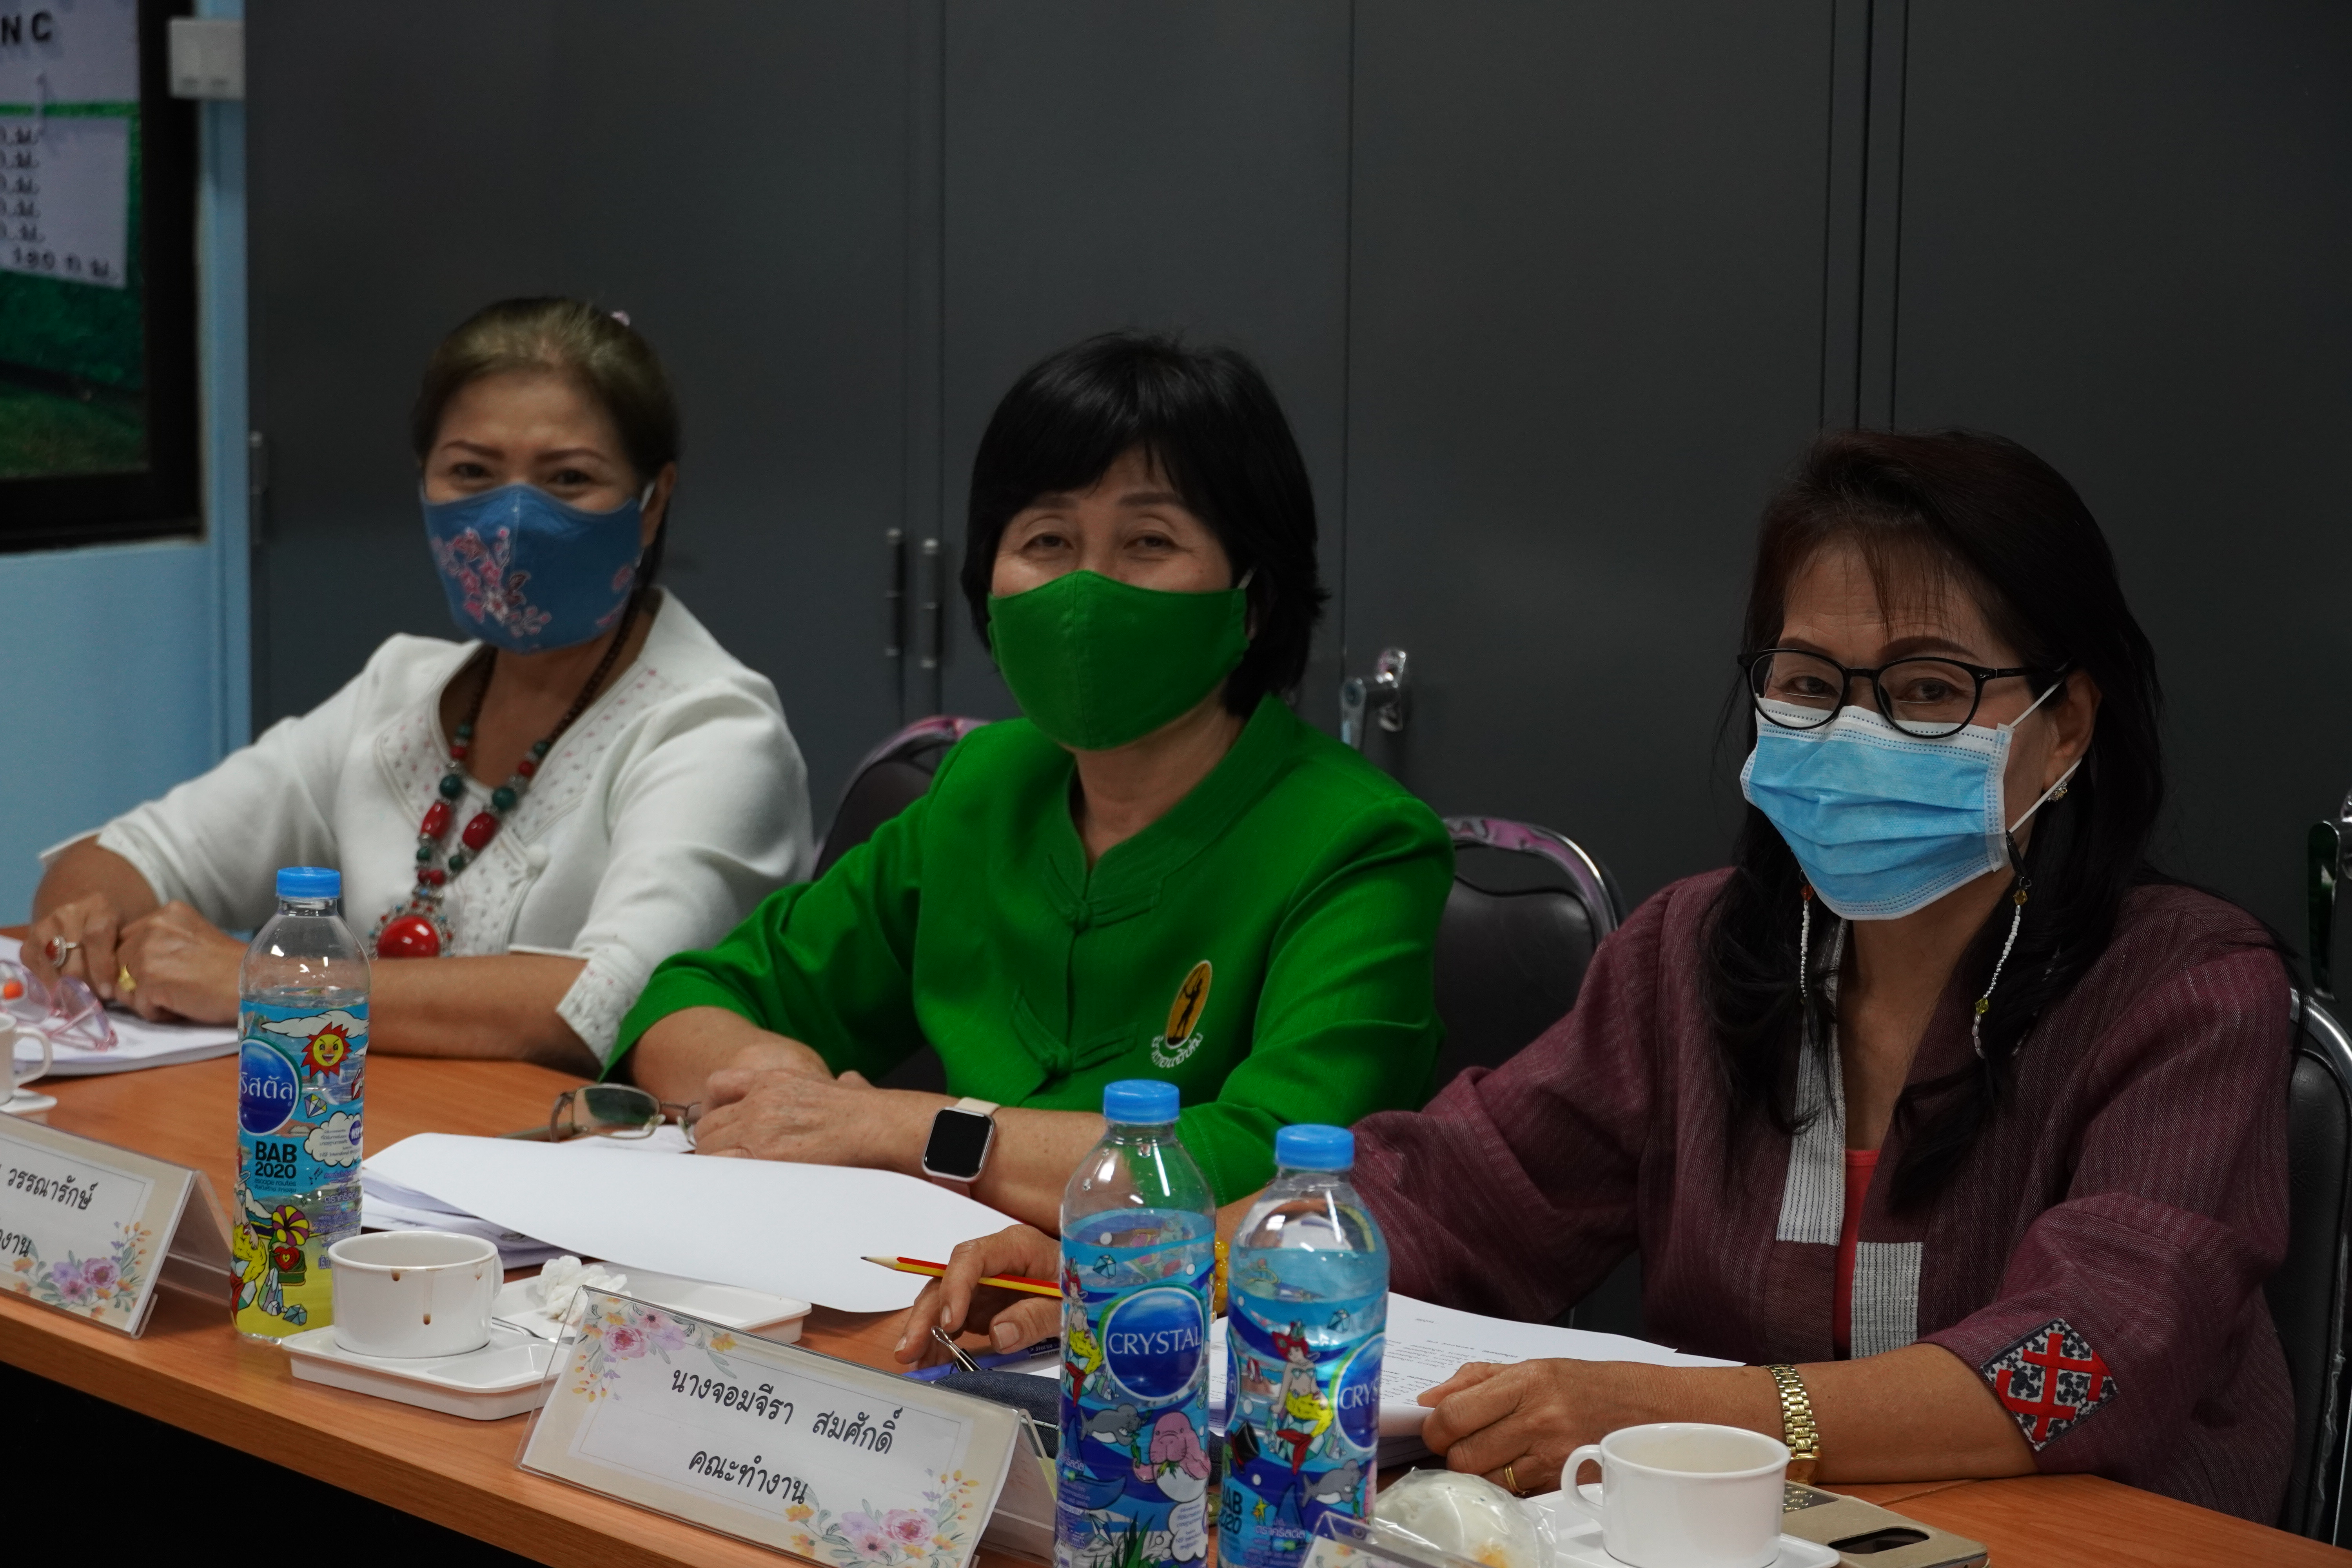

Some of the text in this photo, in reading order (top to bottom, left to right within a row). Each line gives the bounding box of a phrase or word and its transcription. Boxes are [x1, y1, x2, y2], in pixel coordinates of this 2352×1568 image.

[241, 1071, 293, 1100] ริสตัล
[256, 1140, 297, 1163] BAB
[255, 1161, 297, 1179] 2020
[8, 1168, 99, 1210] วรรณารักษ์
[1109, 1326, 1201, 1355] CRYSTAL
[671, 1370, 903, 1455] นางจอมจีรา สมศักดิ์
[688, 1450, 808, 1504] คณะทำงาน
